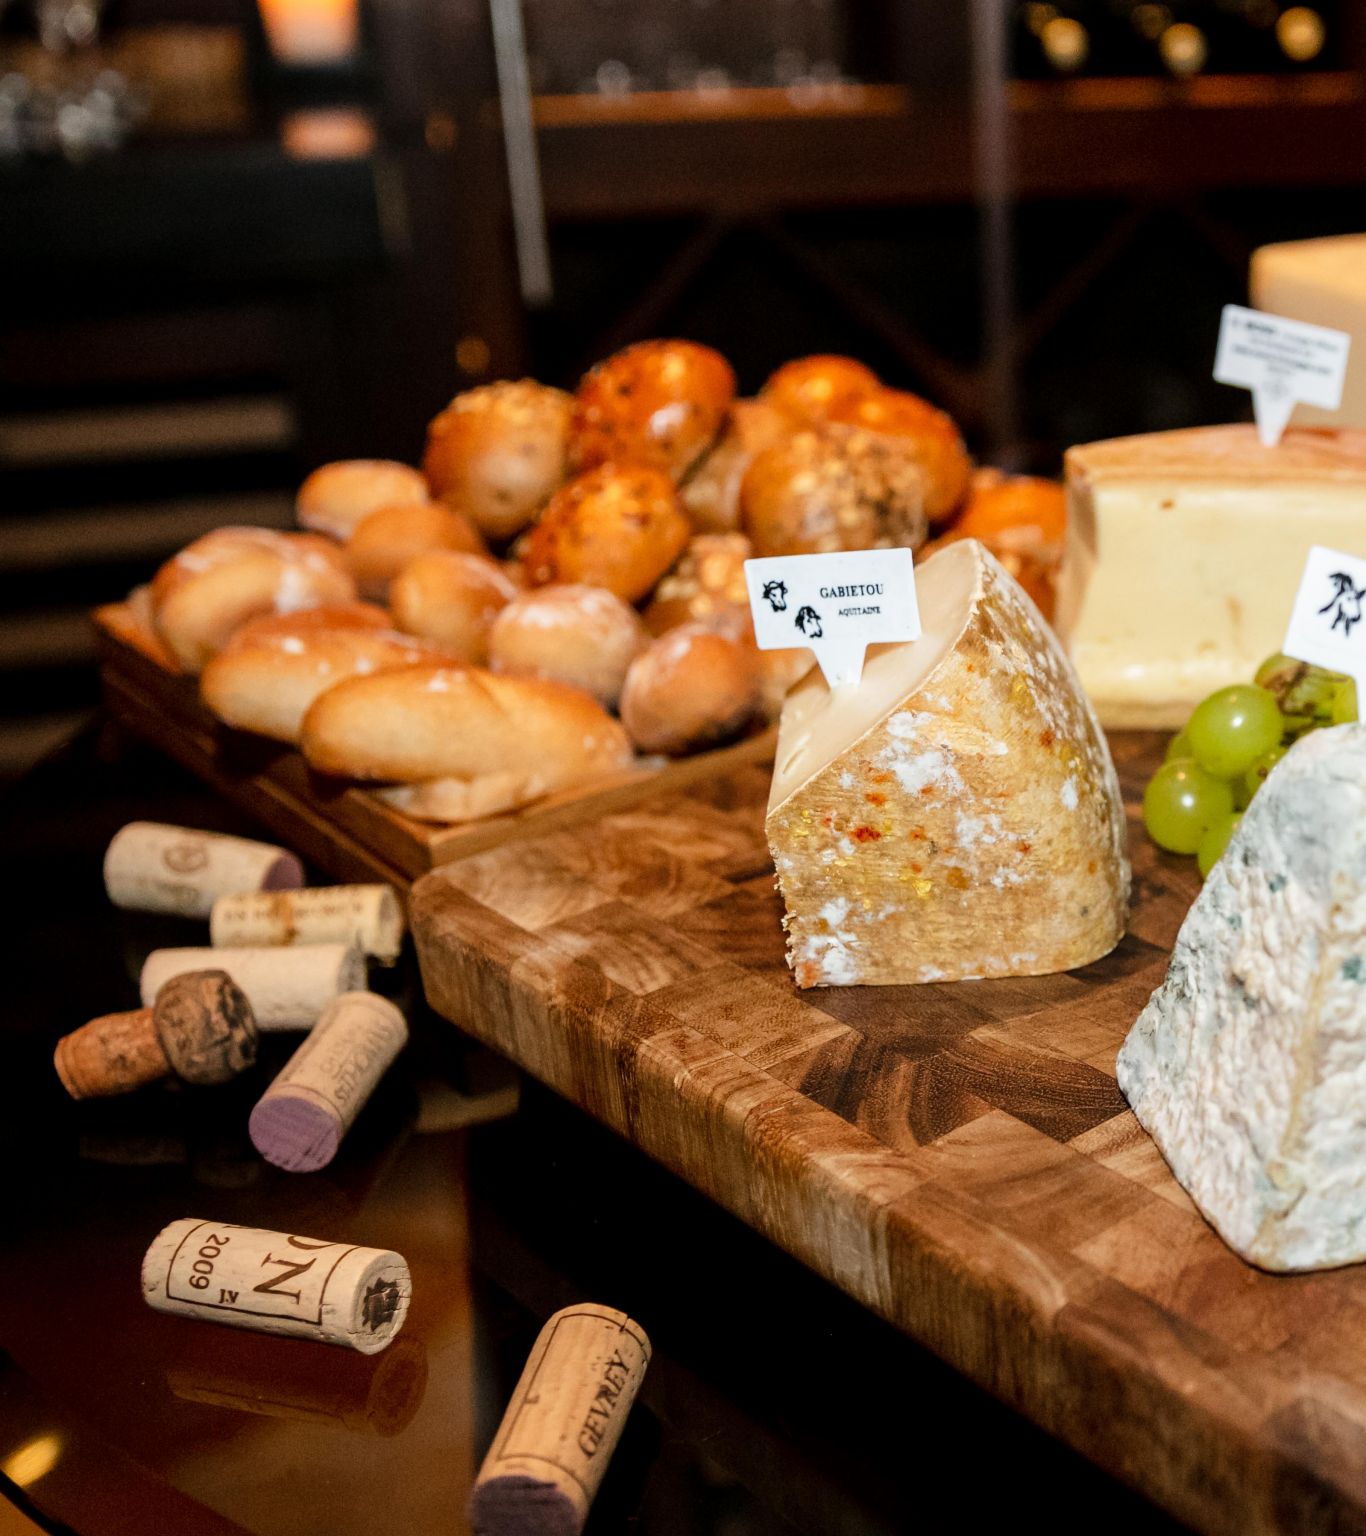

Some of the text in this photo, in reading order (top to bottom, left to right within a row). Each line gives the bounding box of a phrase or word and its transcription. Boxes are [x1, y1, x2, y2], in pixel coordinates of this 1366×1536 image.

[820, 584, 884, 599] GABIETOU
[838, 606, 881, 617] AQUITAINE
[188, 1233, 231, 1291] 2009
[577, 1349, 630, 1460] GEVREY
